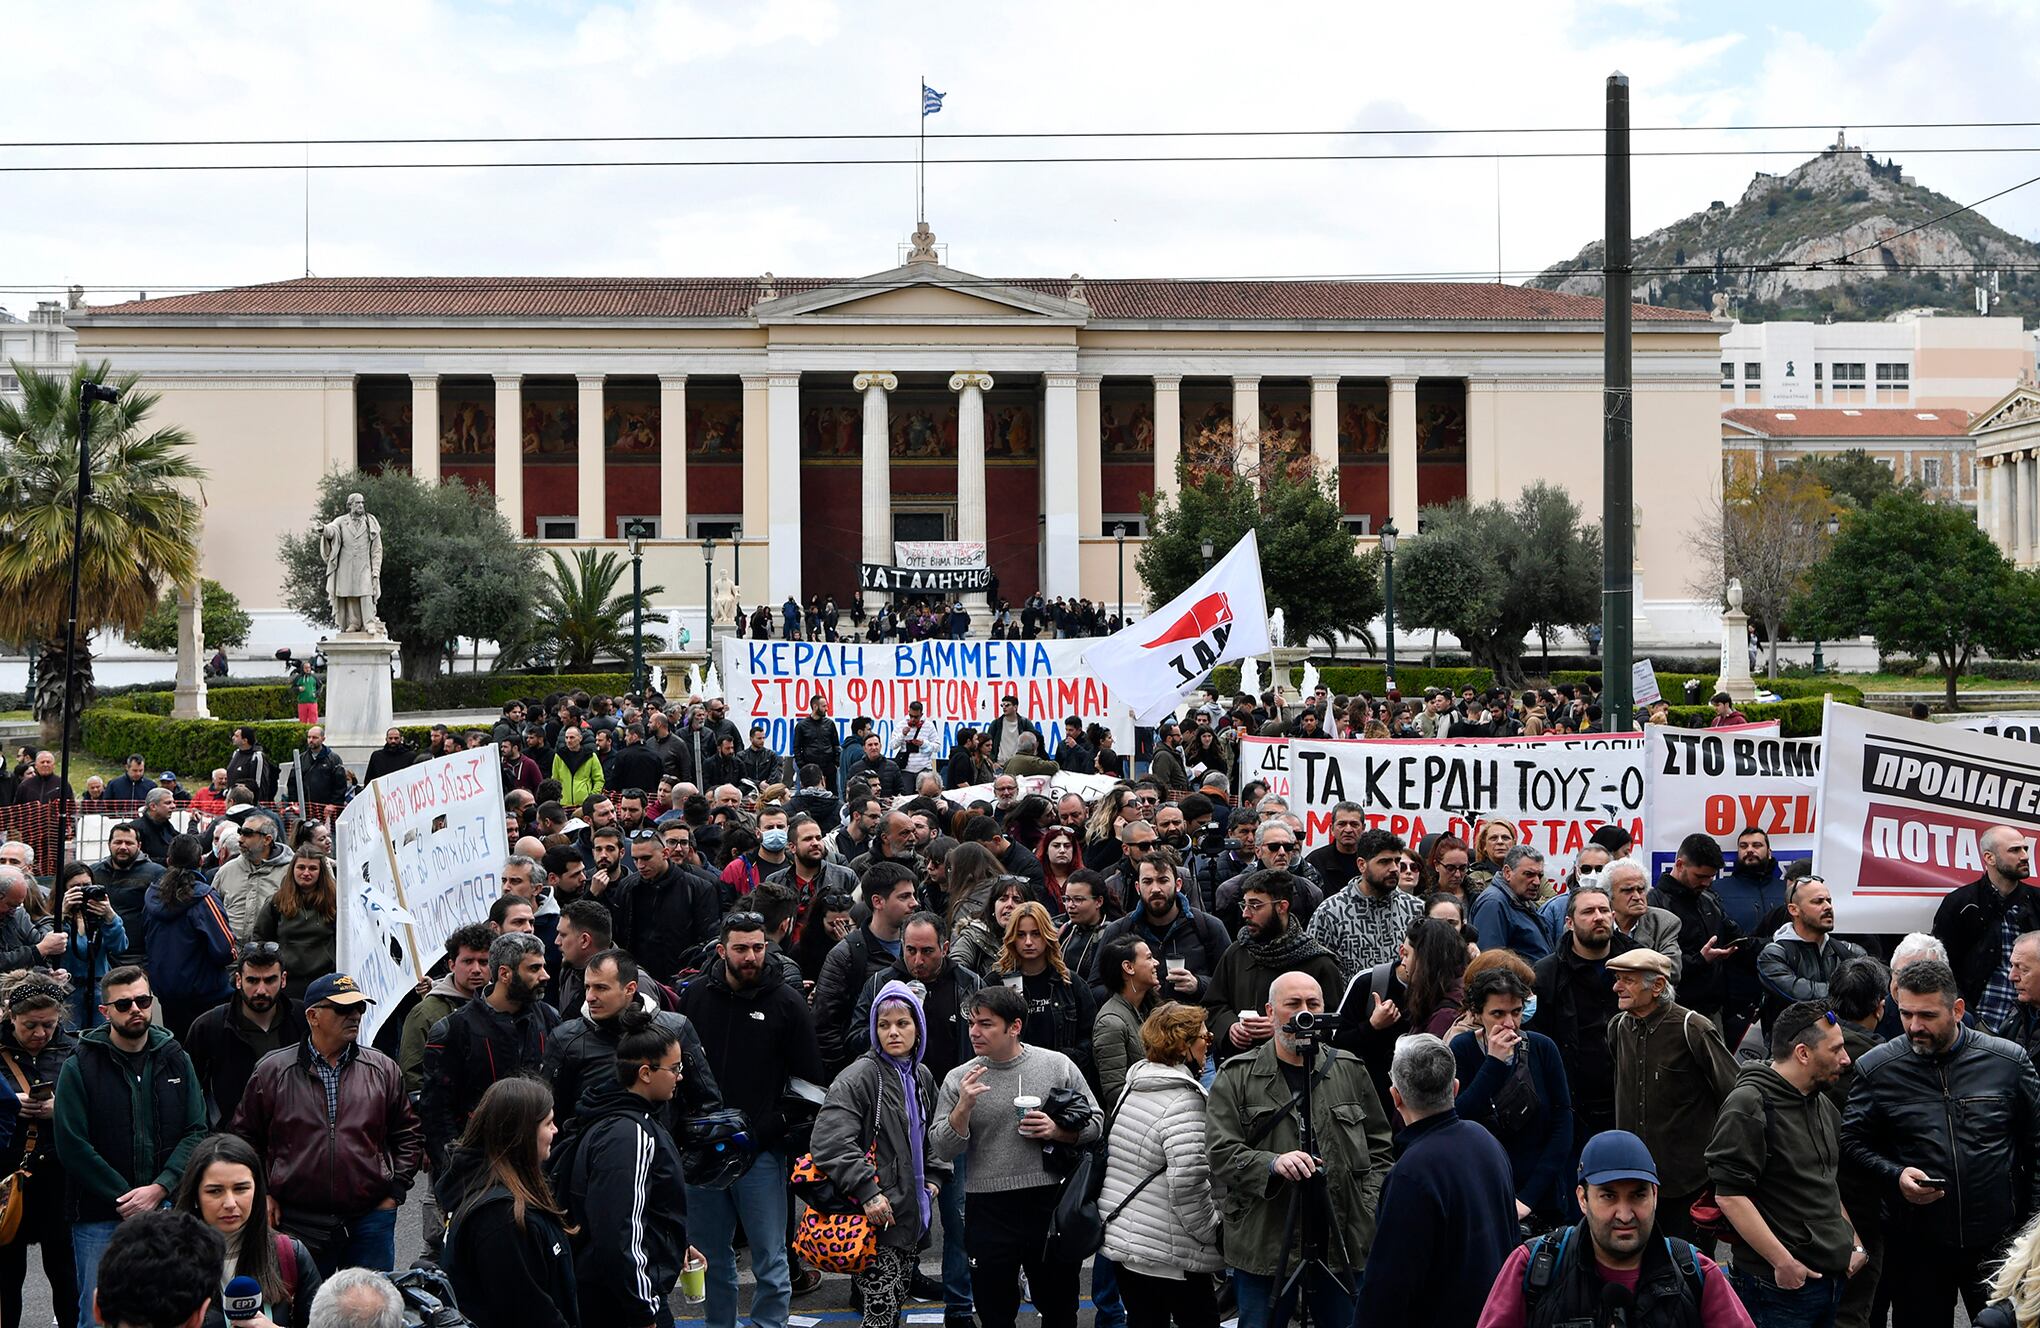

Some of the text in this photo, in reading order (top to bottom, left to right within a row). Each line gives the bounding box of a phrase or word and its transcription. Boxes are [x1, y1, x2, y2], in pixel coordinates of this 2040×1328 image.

[749, 641, 1052, 679] ΚΕΡΔΗ ΒΑΜΜΕΝΑ
[1662, 733, 1823, 778] ΣΤΟ ΒΩΜ
[1298, 751, 1347, 805] ΤΑ
[1364, 755, 1498, 811] ΚΕΡΔΗ
[1872, 753, 2040, 817] ΠΡΟΔΙΑΓΕ
[1305, 811, 1428, 850] ΜΤΡΑ
[235, 1300, 254, 1309] ΕΡΤ
